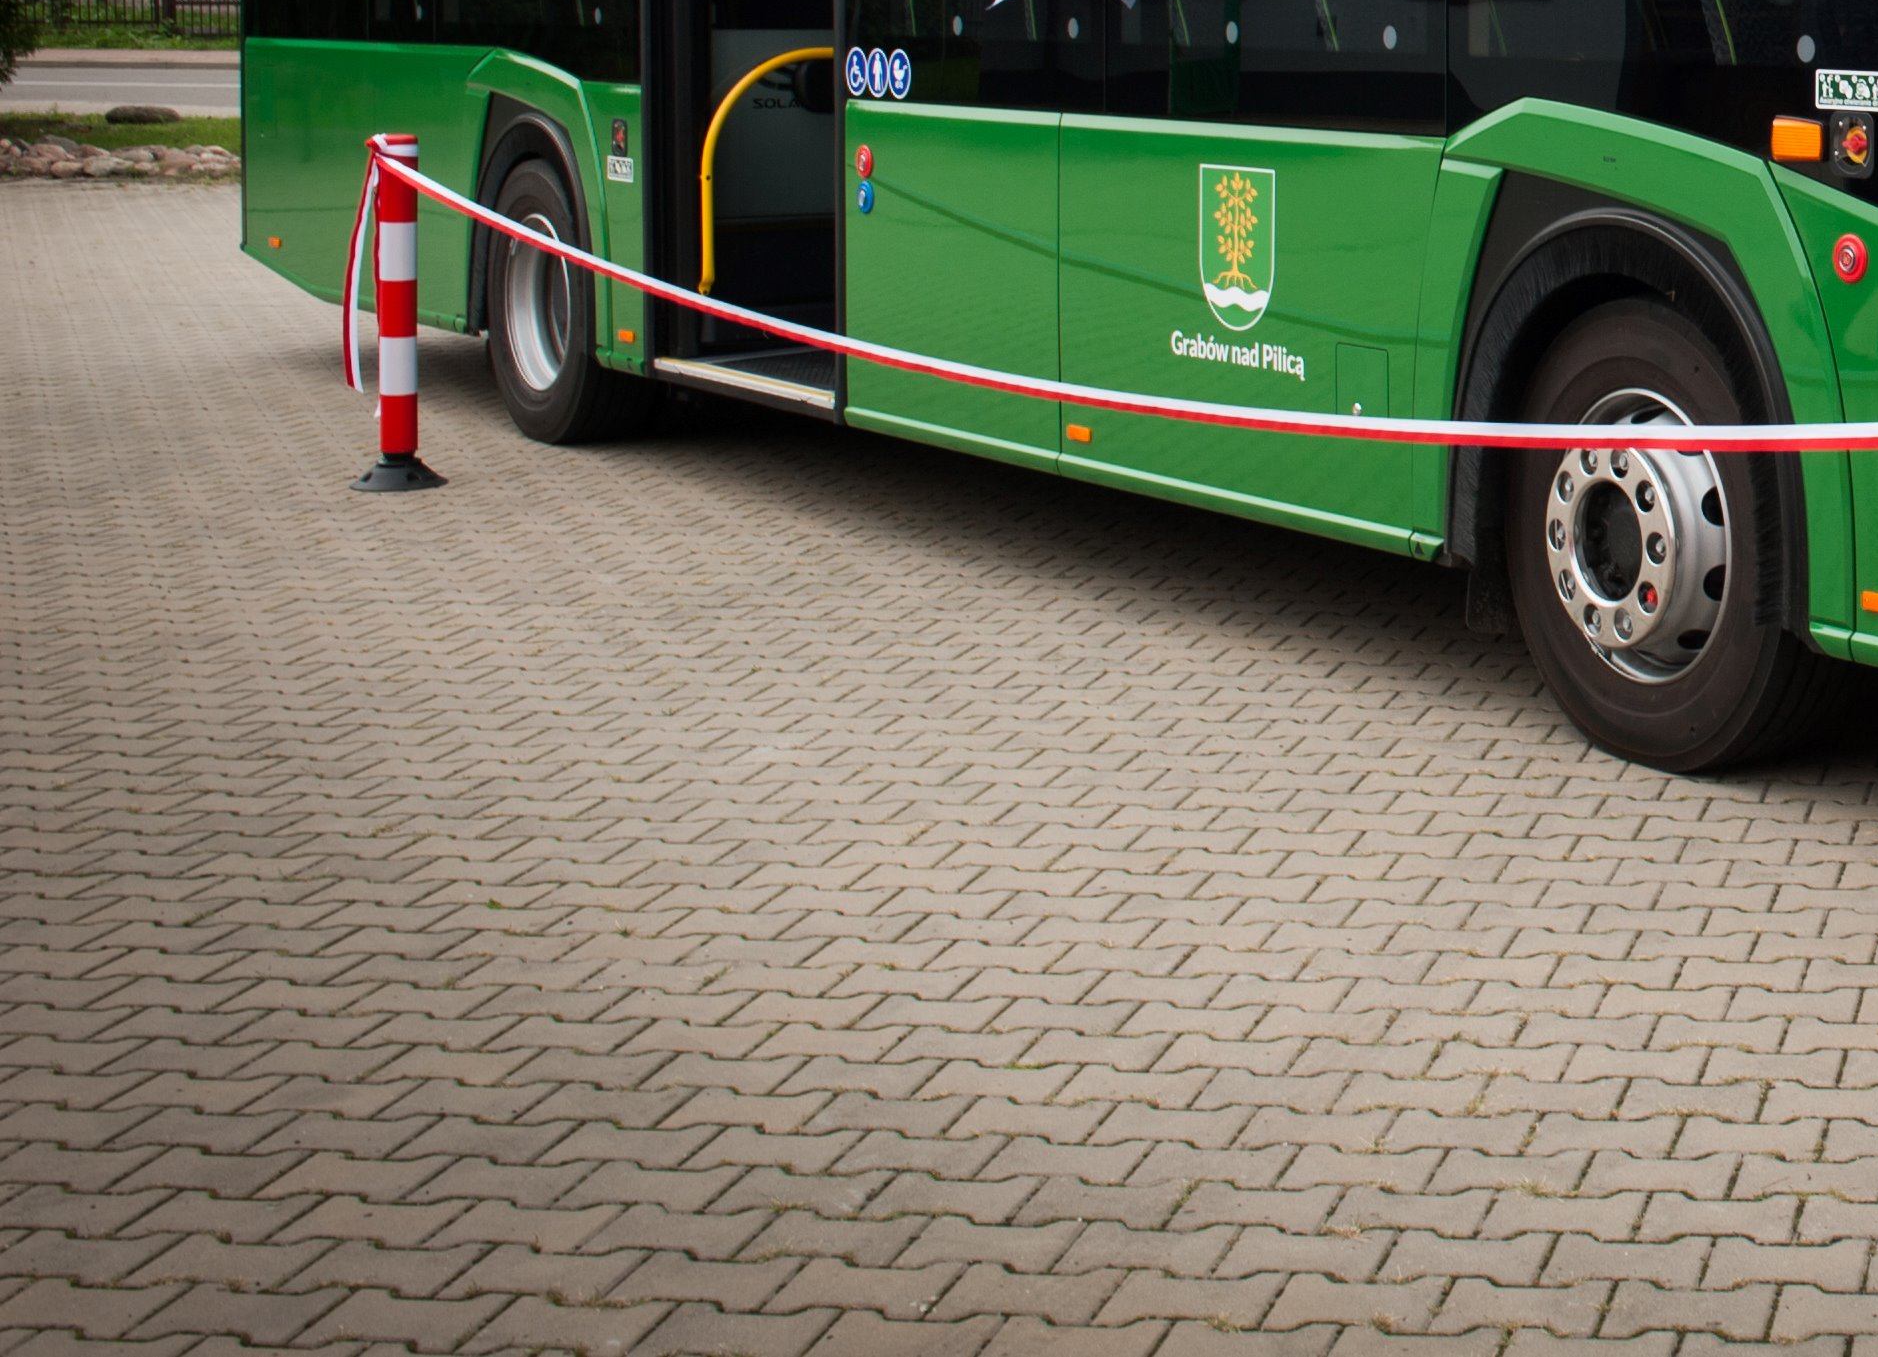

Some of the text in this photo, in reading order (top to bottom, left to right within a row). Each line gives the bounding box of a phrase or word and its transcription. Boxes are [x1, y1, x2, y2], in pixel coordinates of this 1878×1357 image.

[1170, 329, 1306, 382] Grabów nad Pilicą
